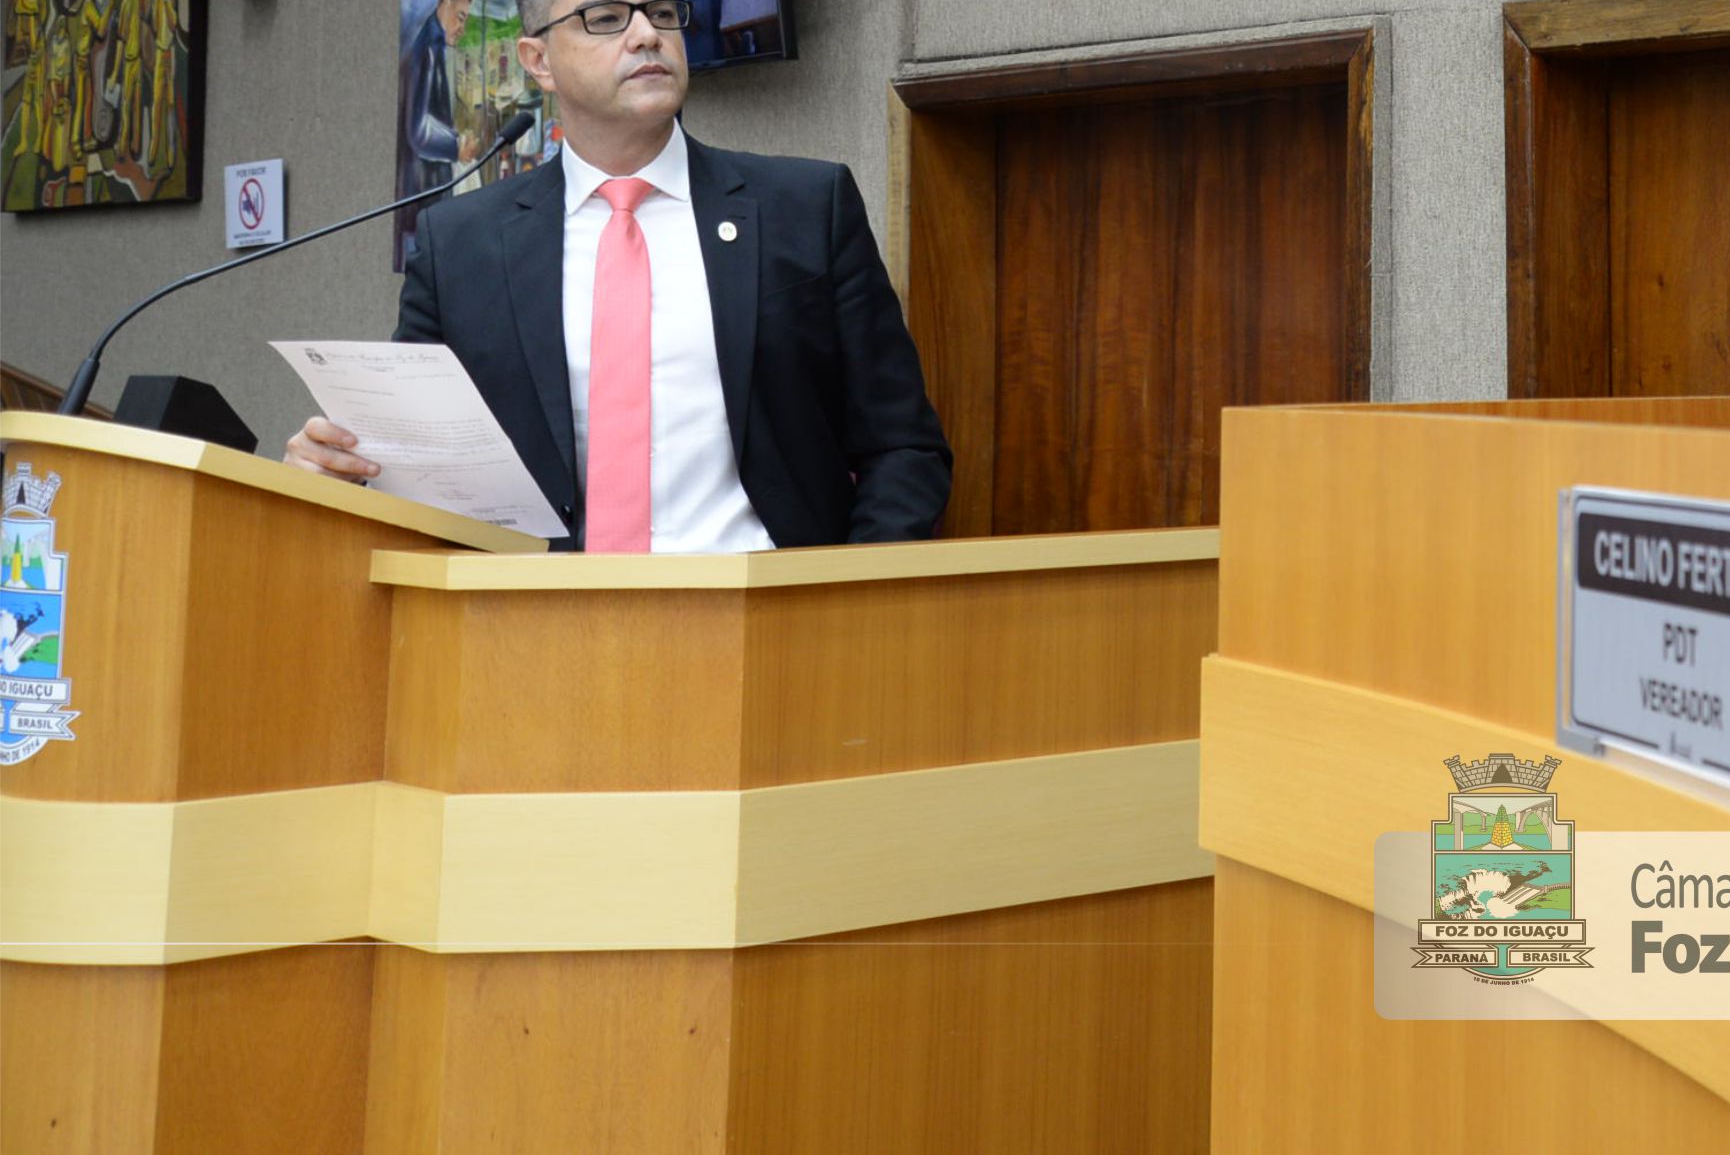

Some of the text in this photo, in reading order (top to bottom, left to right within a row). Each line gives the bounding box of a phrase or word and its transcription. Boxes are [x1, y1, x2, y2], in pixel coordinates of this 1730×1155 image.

[1594, 531, 1674, 587] CELINO
[1662, 622, 1699, 667] PDT
[9, 681, 53, 701] IGUAÇU
[1640, 677, 1723, 731] VEREADOR
[17, 717, 53, 730] BRASIL
